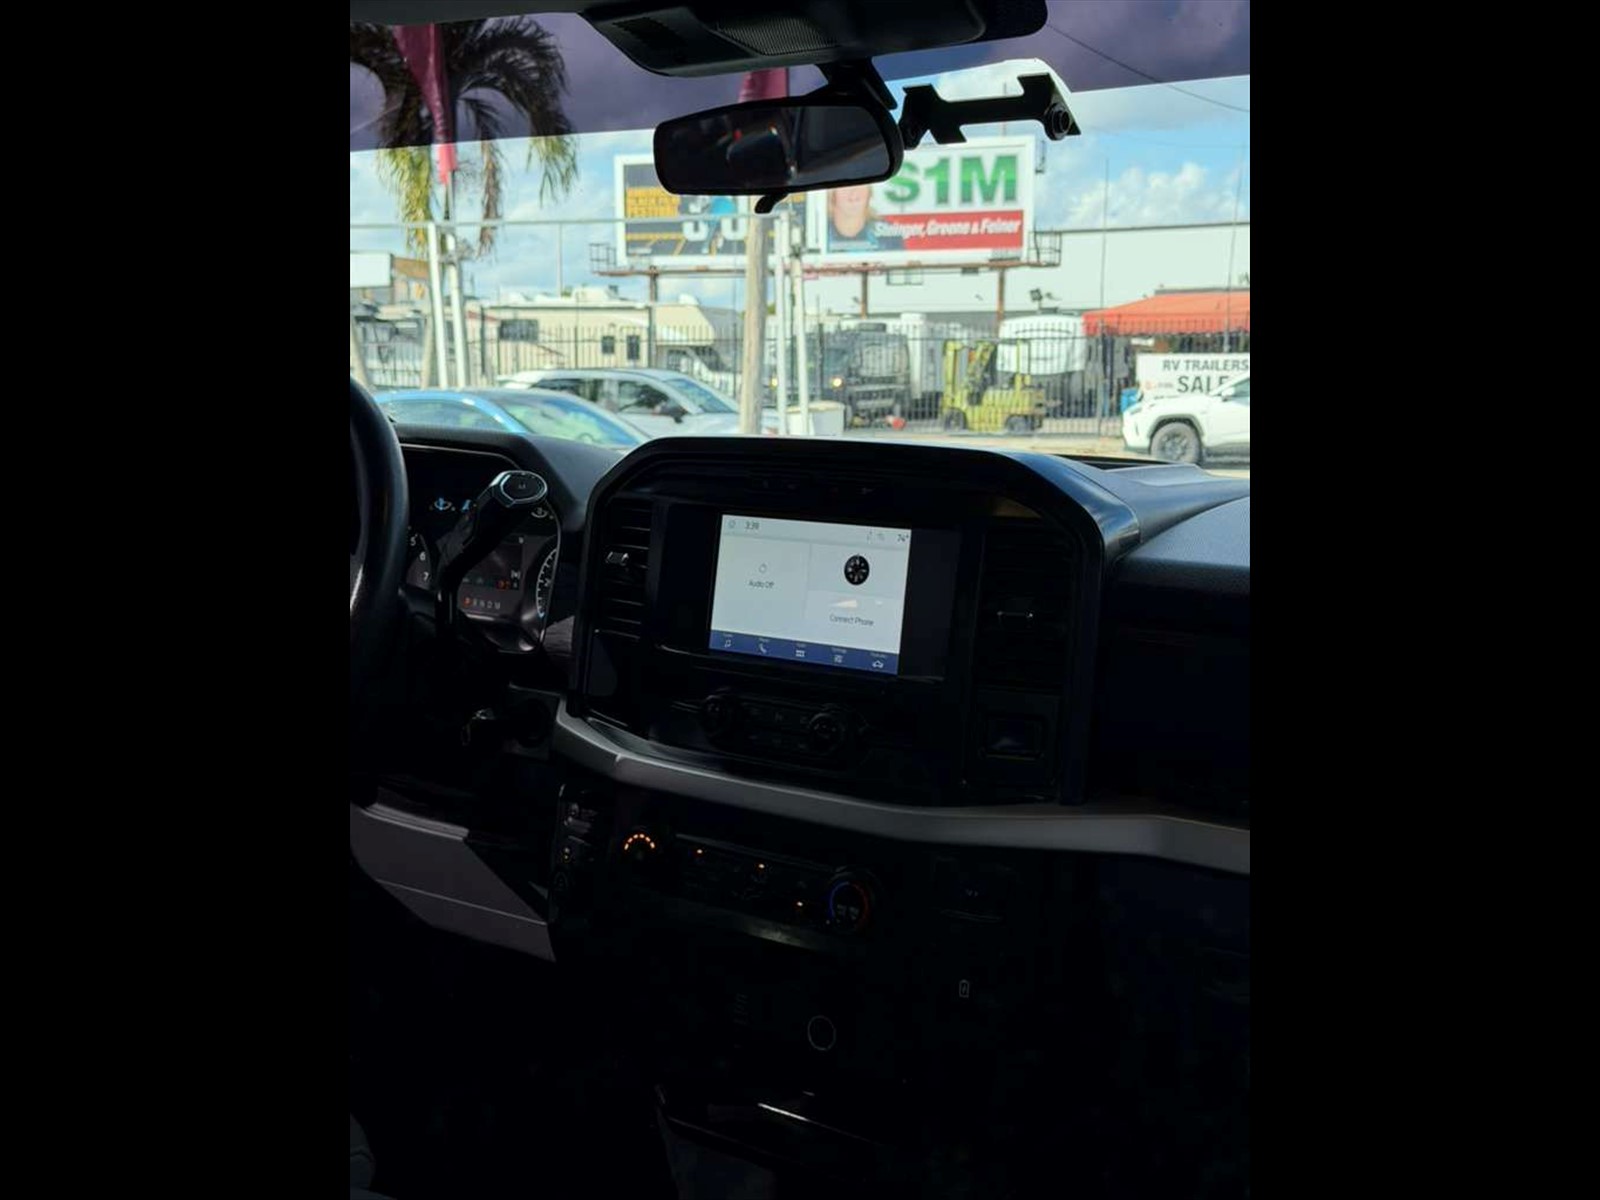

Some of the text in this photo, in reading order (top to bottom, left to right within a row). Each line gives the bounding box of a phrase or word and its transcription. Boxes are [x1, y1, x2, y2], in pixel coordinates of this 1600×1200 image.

[1163, 359, 1250, 371] RV TRAILERS
[829, 613, 874, 627] Connect Phone
